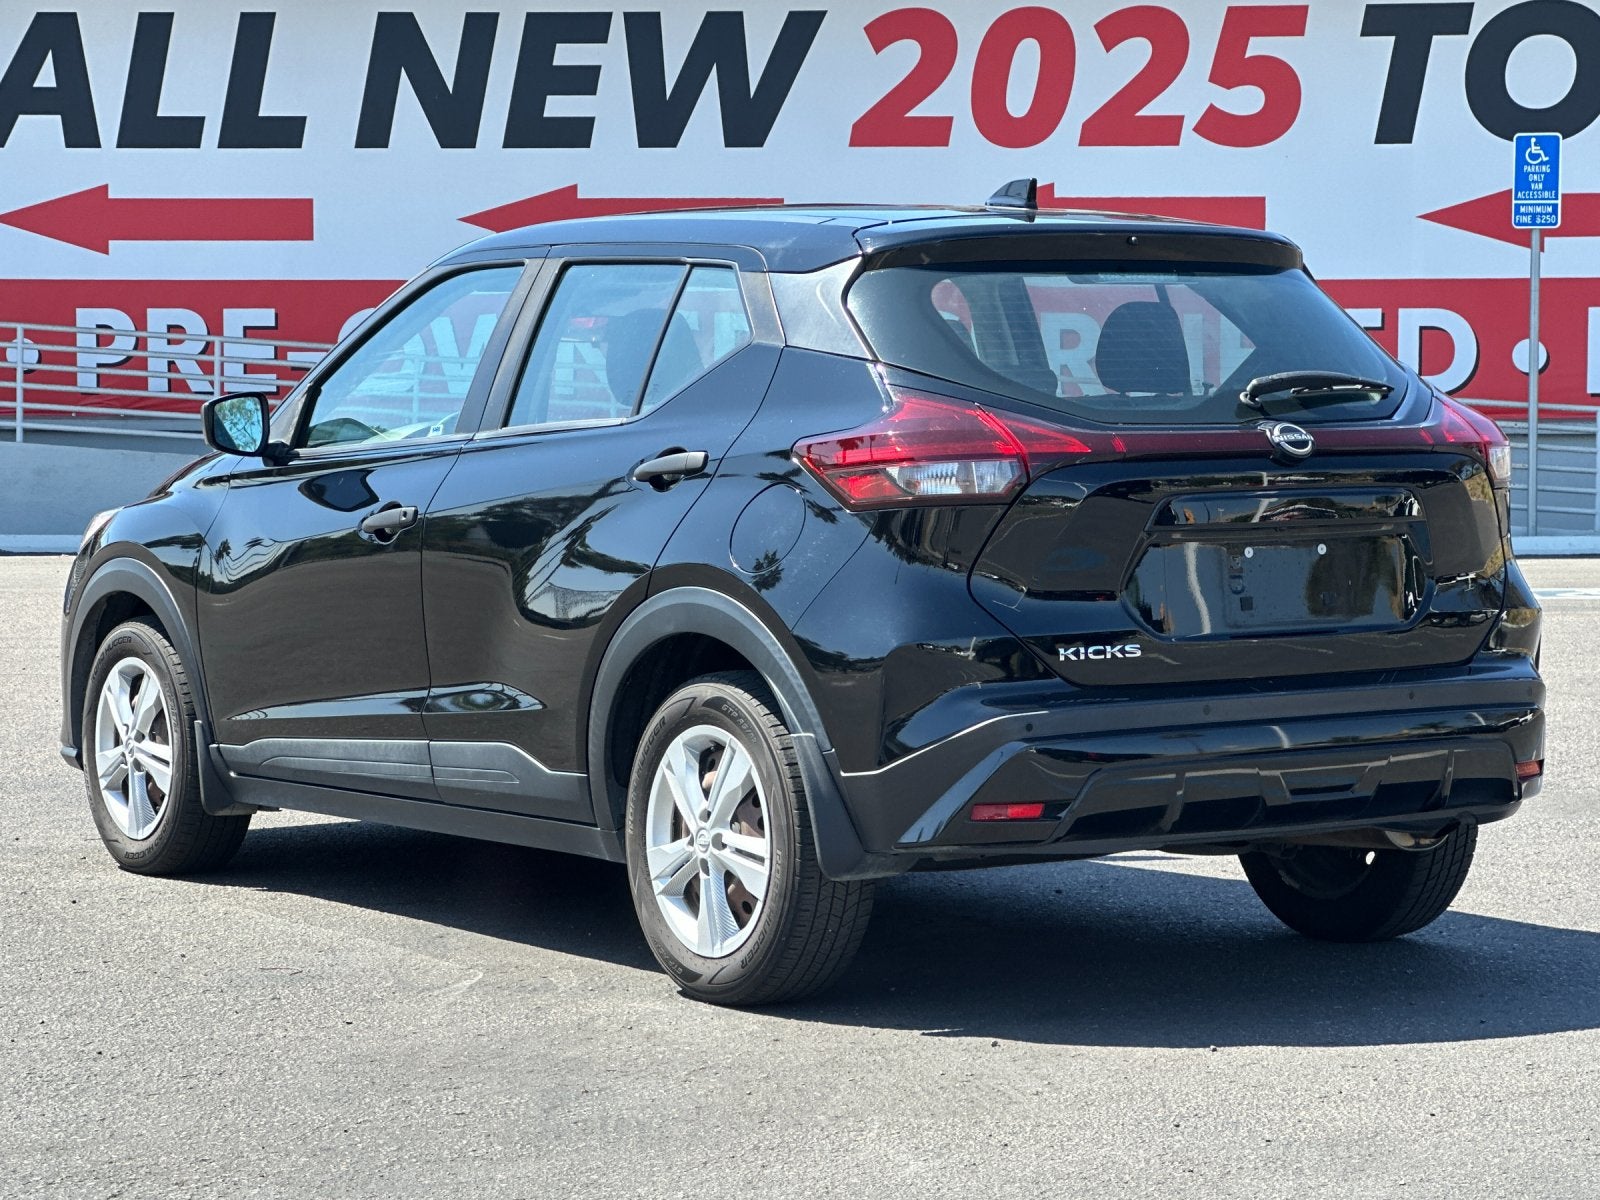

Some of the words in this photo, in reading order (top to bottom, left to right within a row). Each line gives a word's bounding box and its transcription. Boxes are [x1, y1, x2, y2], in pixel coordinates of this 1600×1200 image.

[0, 11, 307, 149] ALL
[354, 11, 826, 149] NEW
[848, 5, 1306, 149] 2025
[1523, 165, 1551, 173] PARKING
[1531, 182, 1543, 190] VAN
[1517, 190, 1556, 199] ACCESSIBLE
[1520, 205, 1553, 213] MINIMUM
[1515, 215, 1532, 223] FINE
[1535, 215, 1556, 224] $250
[1272, 433, 1312, 443] NISSAN
[1058, 643, 1142, 662] KICKS
